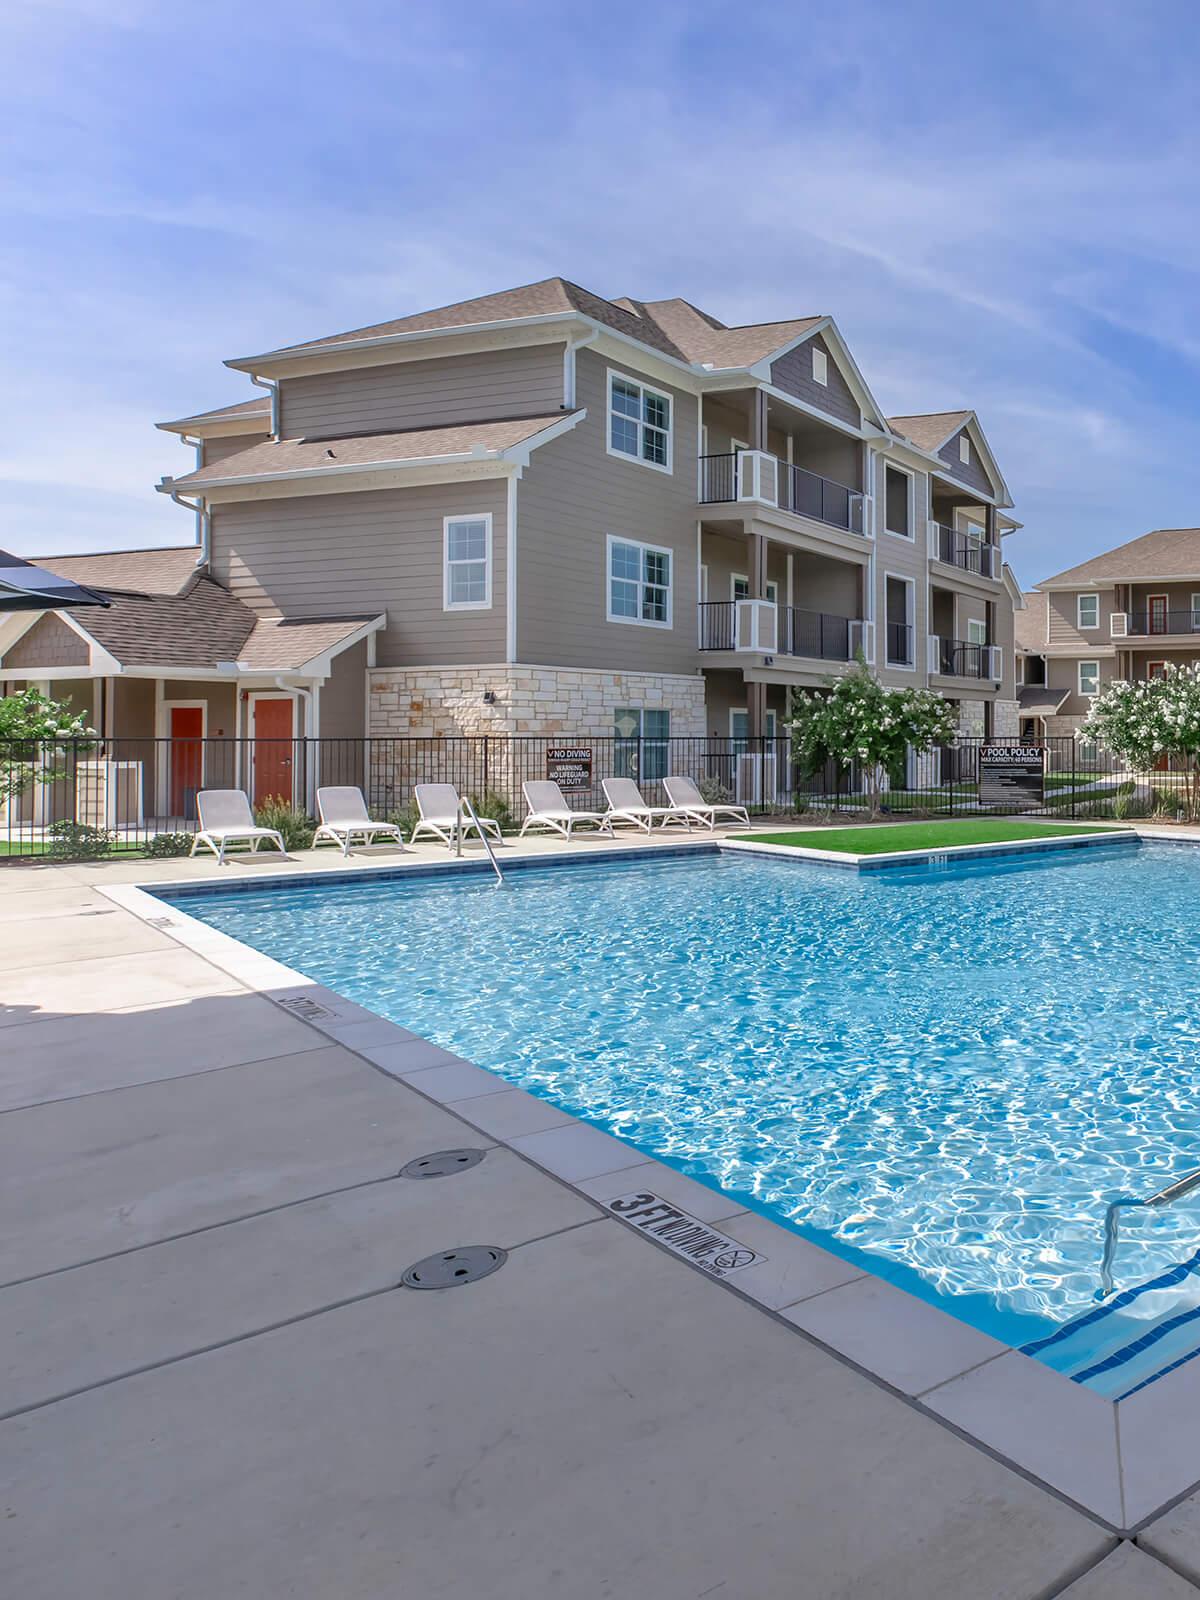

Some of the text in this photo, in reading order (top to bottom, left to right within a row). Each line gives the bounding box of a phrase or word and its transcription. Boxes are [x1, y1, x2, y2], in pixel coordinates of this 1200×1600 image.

[987, 748, 1009, 756] POOL
[1011, 748, 1040, 756] POLICY
[610, 1194, 655, 1212] 3
[653, 1218, 695, 1240] NO
[671, 1227, 730, 1259] DIVING
